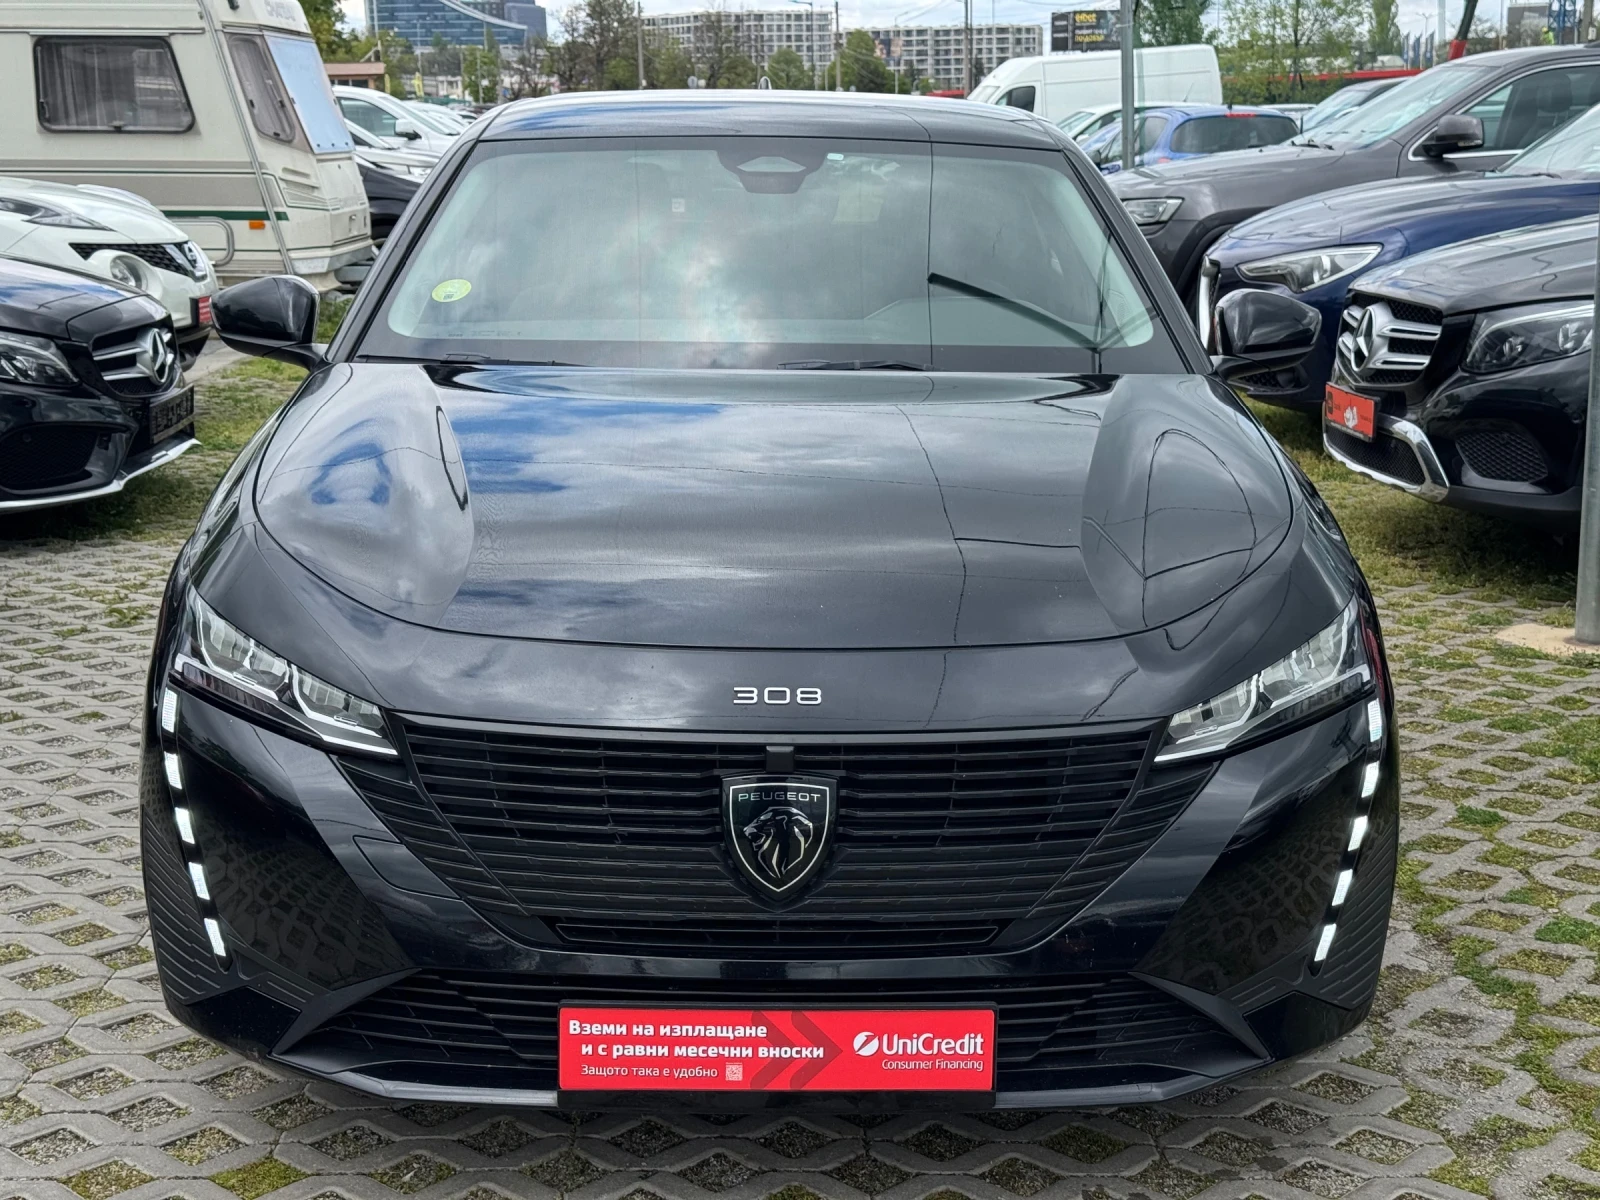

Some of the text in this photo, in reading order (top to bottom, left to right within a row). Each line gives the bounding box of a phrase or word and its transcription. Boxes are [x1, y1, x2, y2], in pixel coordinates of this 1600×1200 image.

[733, 686, 822, 705] 308
[738, 791, 821, 802] PEUGEOT
[569, 1020, 767, 1039] Вземи на изплащане
[581, 1043, 824, 1059] и с равни месечни вноски
[882, 1033, 984, 1055] UniCredit
[581, 1065, 718, 1079] Защото така е удобно
[882, 1058, 984, 1072] Consumer Financing
